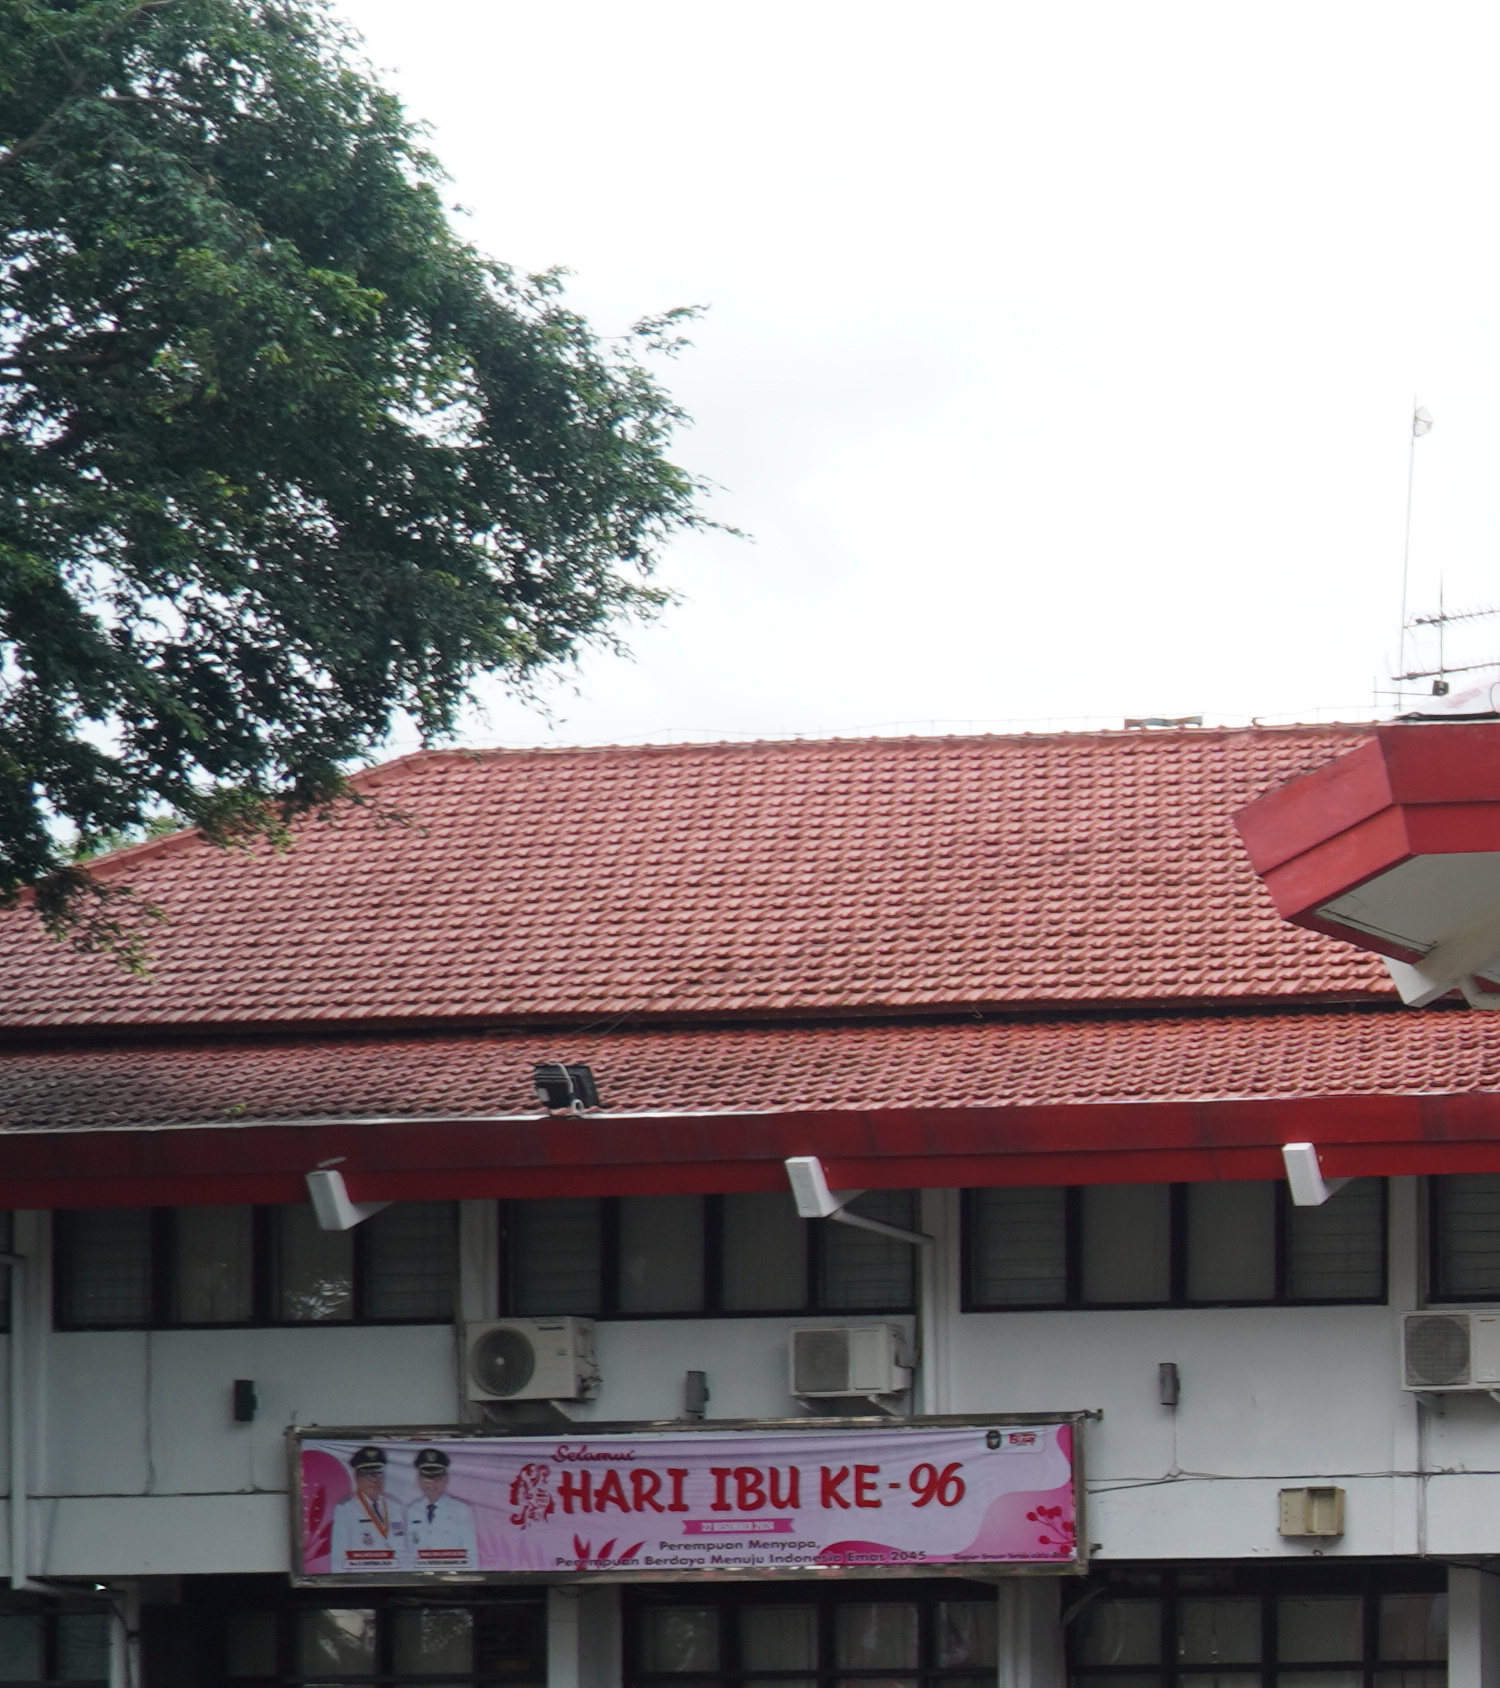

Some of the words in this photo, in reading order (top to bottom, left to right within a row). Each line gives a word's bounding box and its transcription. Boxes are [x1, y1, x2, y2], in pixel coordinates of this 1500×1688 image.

[557, 1467, 690, 1515] HARI
[710, 1464, 801, 1513] IBU
[659, 1540, 744, 1552] Perempuan
[748, 1539, 822, 1552] Menyapa,
[555, 1556, 641, 1569] Perempuan
[645, 1555, 706, 1568] Berdaya
[710, 1553, 765, 1566] Menuju
[769, 1551, 846, 1564] Indonesia
[848, 1551, 886, 1562] Emas
[890, 1551, 927, 1562] 2045
